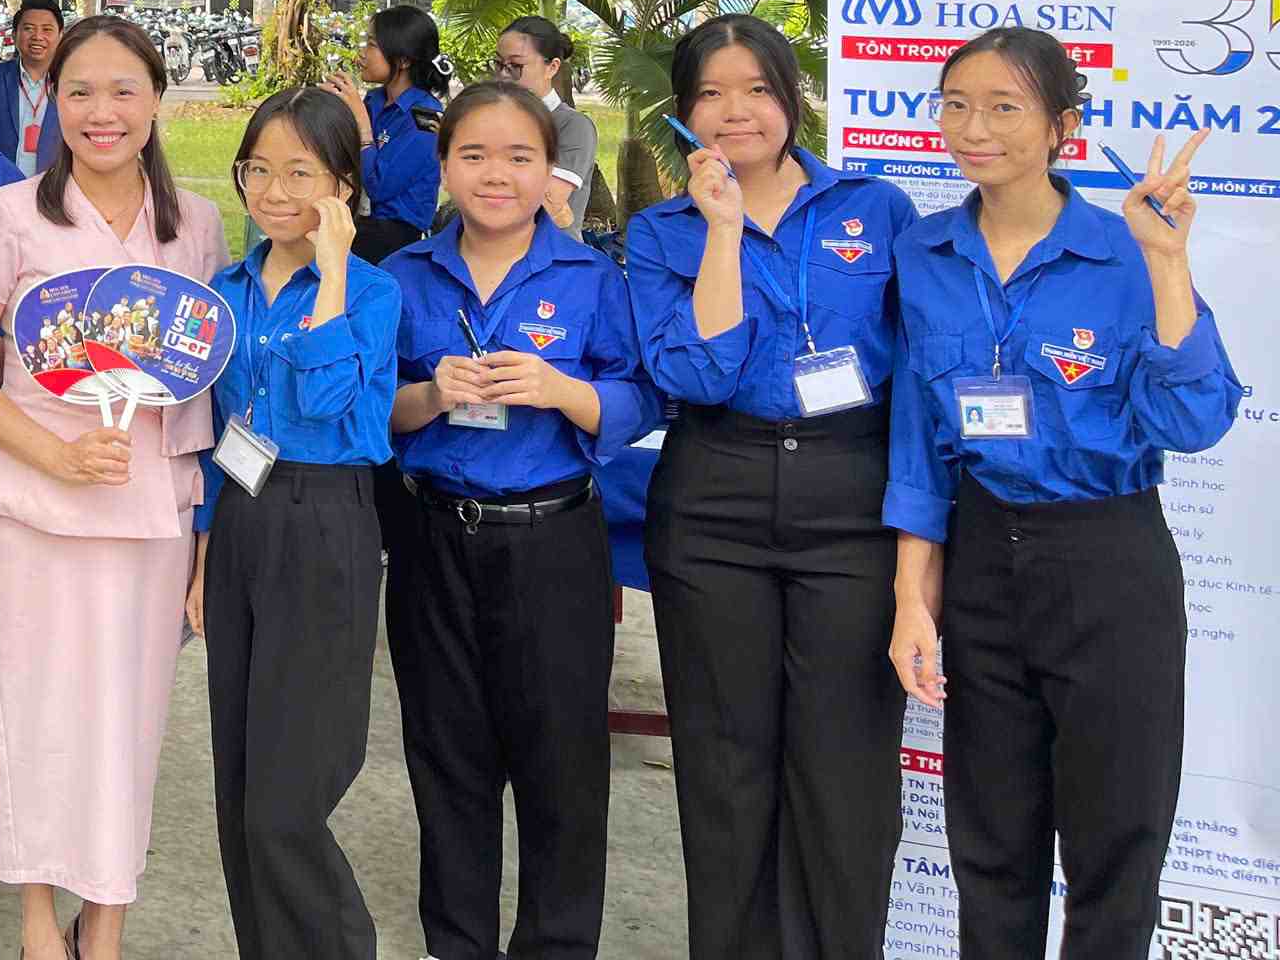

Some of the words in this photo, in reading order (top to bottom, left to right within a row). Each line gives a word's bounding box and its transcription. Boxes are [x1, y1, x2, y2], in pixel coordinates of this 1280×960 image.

[936, 2, 1021, 29] HOA
[1036, 4, 1115, 31] SEN
[856, 39, 892, 55] TÔN
[896, 44, 961, 60] TRỌNG
[1152, 39, 1196, 47] 1991-2026
[1131, 94, 1240, 132] NĂM
[848, 132, 923, 148] CHƯƠNG
[847, 162, 867, 171] STT
[883, 164, 940, 176] CHƯƠNG
[1187, 179, 1208, 191] ỢP
[1211, 181, 1245, 192] MÔN
[1248, 182, 1276, 194] XÉT
[176, 294, 219, 322] HOA
[171, 316, 217, 346] SEN
[1171, 478, 1199, 488] Sinh
[1206, 553, 1232, 566] Anh
[1226, 581, 1255, 593] Kinh
[908, 778, 926, 789] TN
[917, 808, 939, 821] Nội
[1176, 846, 1213, 861] THPT
[1217, 851, 1249, 866] theo
[903, 857, 950, 879] TÂM
[1172, 860, 1189, 872] 03
